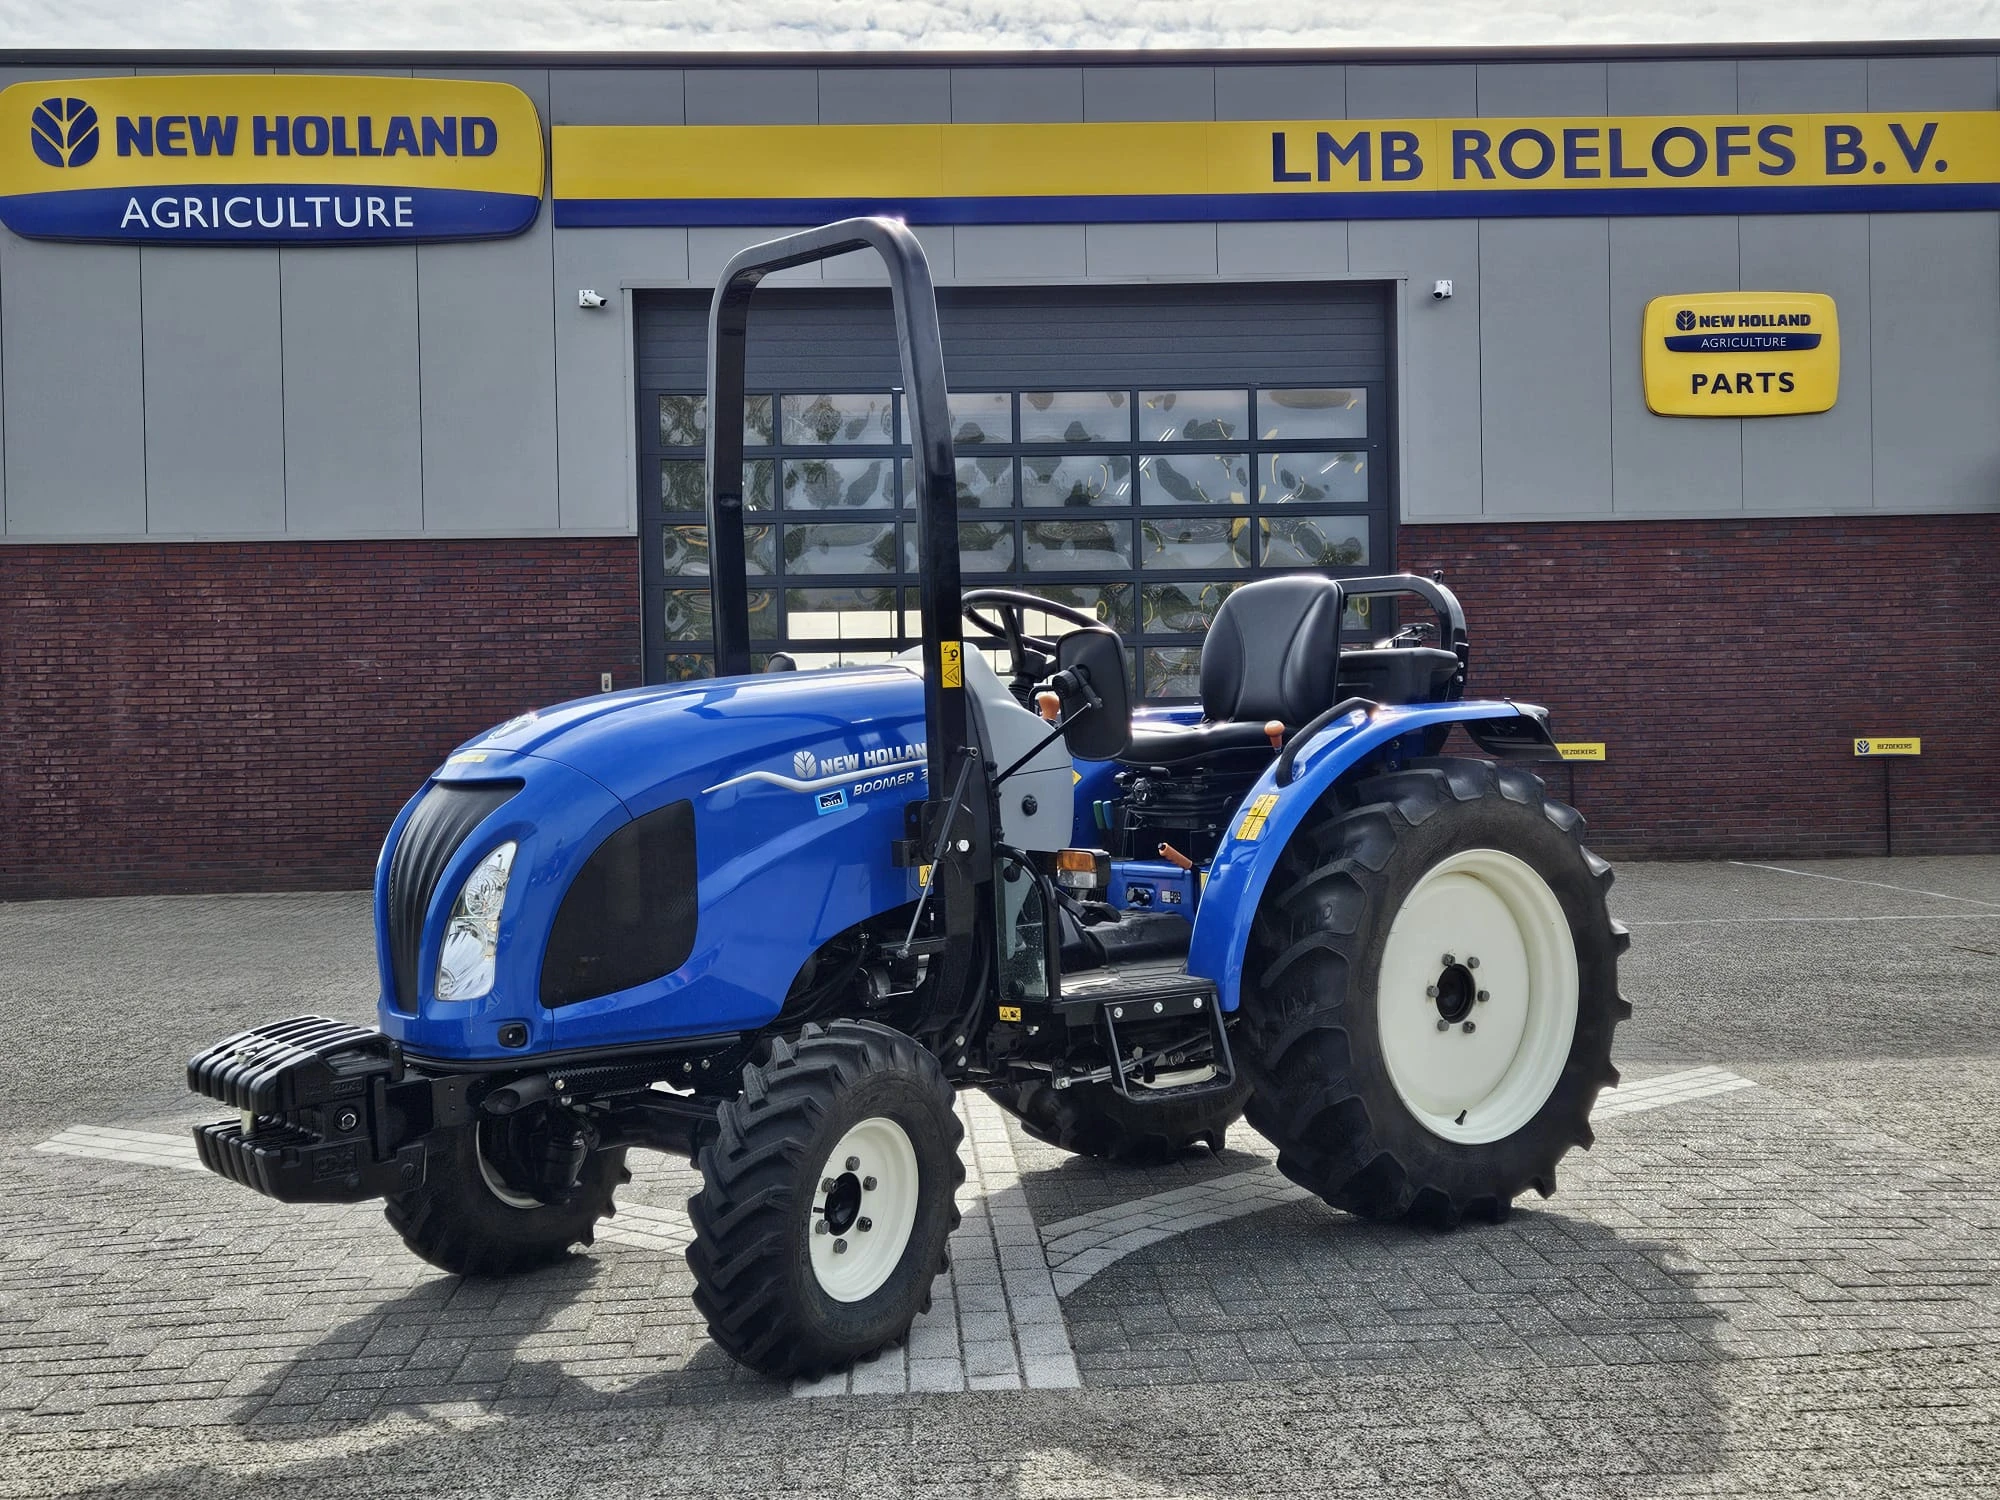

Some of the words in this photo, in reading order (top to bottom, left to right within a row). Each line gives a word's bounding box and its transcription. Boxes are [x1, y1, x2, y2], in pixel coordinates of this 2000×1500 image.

[116, 115, 239, 157] NEW
[252, 115, 498, 157] HOLLAND
[1272, 130, 1424, 182] LMB
[1451, 124, 1797, 180] ROELOFS
[1824, 122, 1948, 175] B.V.
[120, 196, 414, 228] AGRICULTURE
[1699, 315, 1735, 328] NEW
[1738, 313, 1812, 327] HOLLAND
[1701, 336, 1787, 348] AGRICULTURE
[1691, 372, 1796, 395] PARTS
[821, 753, 859, 776] NEW
[863, 743, 927, 767] HOLLAN
[853, 772, 914, 796] BOOMER
[920, 769, 928, 780] 3
